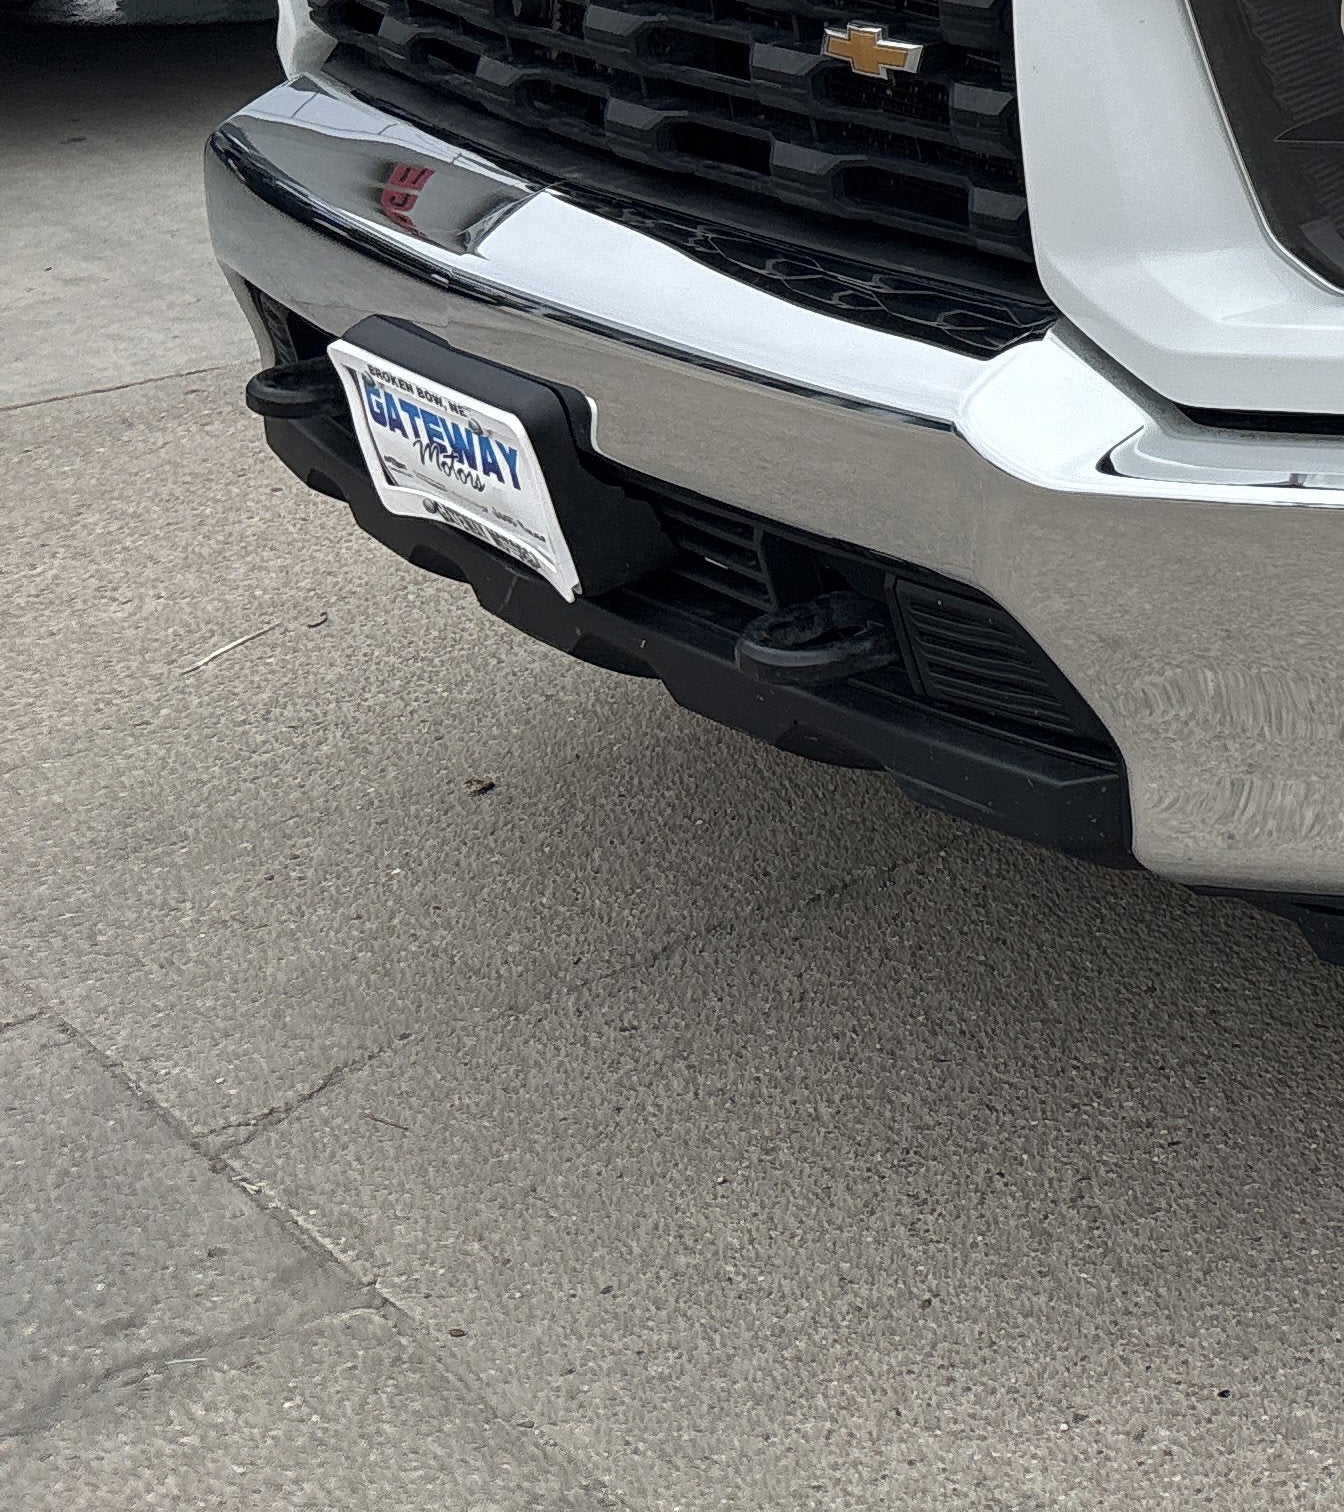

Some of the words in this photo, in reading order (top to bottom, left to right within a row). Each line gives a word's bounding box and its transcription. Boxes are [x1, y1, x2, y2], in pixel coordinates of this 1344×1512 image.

[367, 364, 414, 394] BROKEN
[416, 387, 447, 411] BOW,
[450, 401, 468, 418] NE
[364, 381, 521, 491] GATEWAY
[412, 439, 486, 492] Motors
